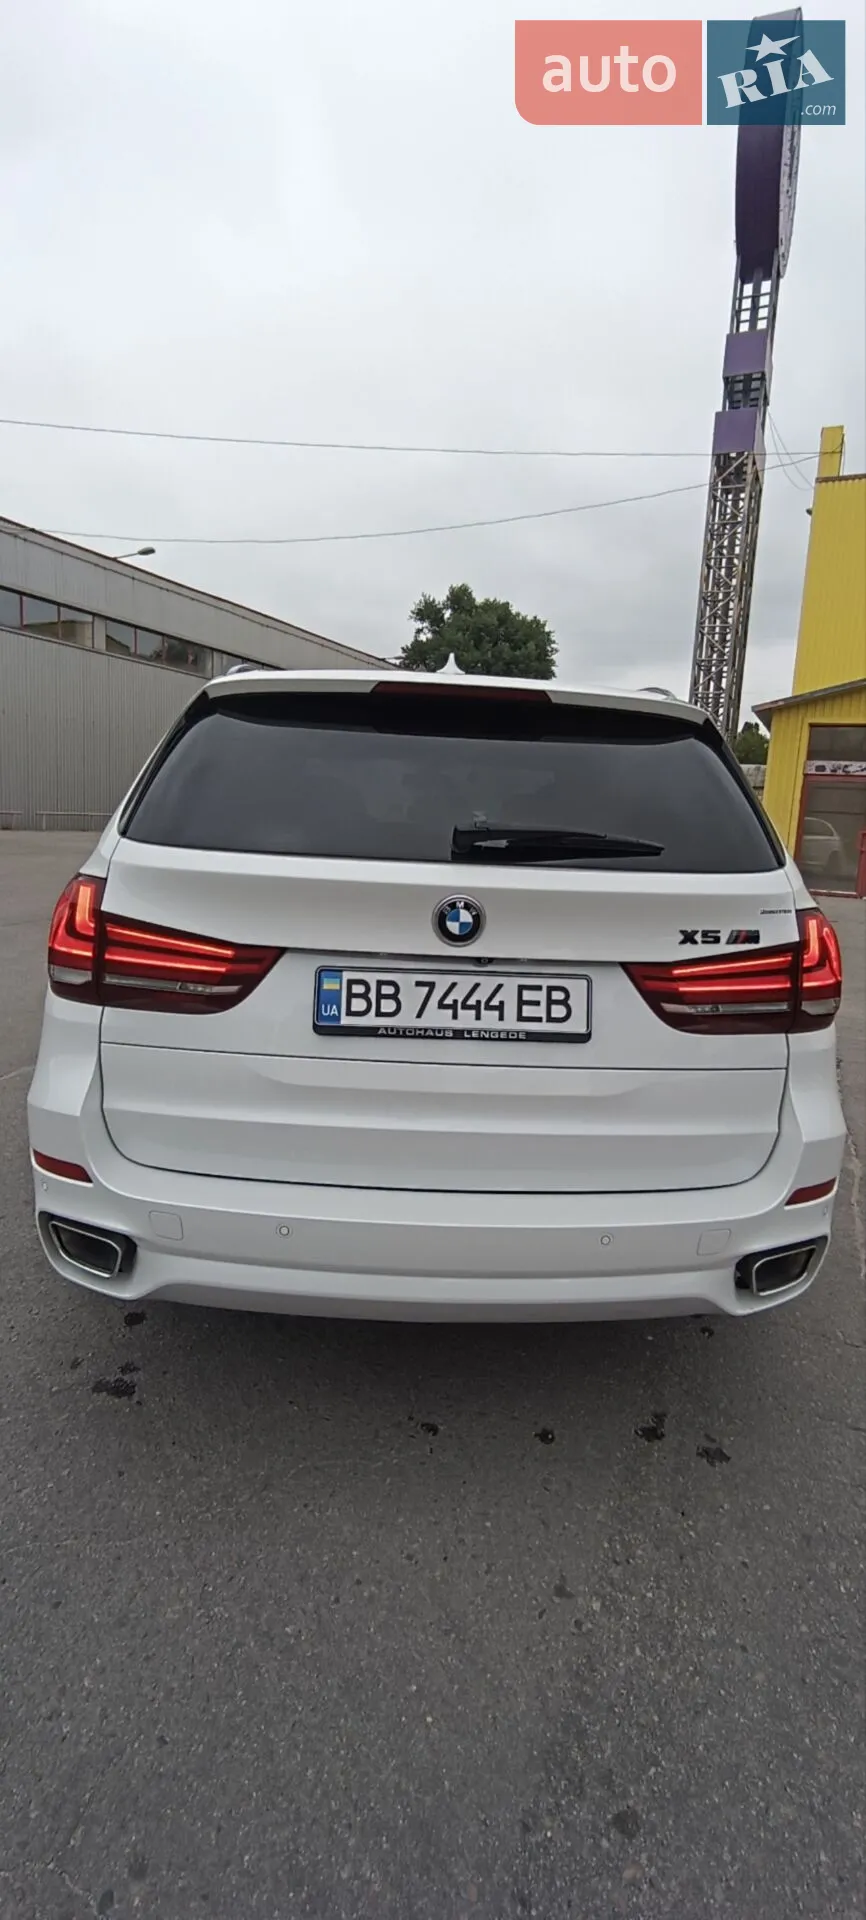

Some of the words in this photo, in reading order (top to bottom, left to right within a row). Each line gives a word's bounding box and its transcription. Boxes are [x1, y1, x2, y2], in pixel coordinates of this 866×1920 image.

[678, 929, 721, 945] X5
[345, 978, 401, 1018] BB
[414, 980, 504, 1021] 7444
[516, 984, 573, 1024] EB
[321, 1004, 339, 1017] UA
[377, 1027, 454, 1038] AUTOHAUS
[463, 1030, 527, 1040] LENGEDE
